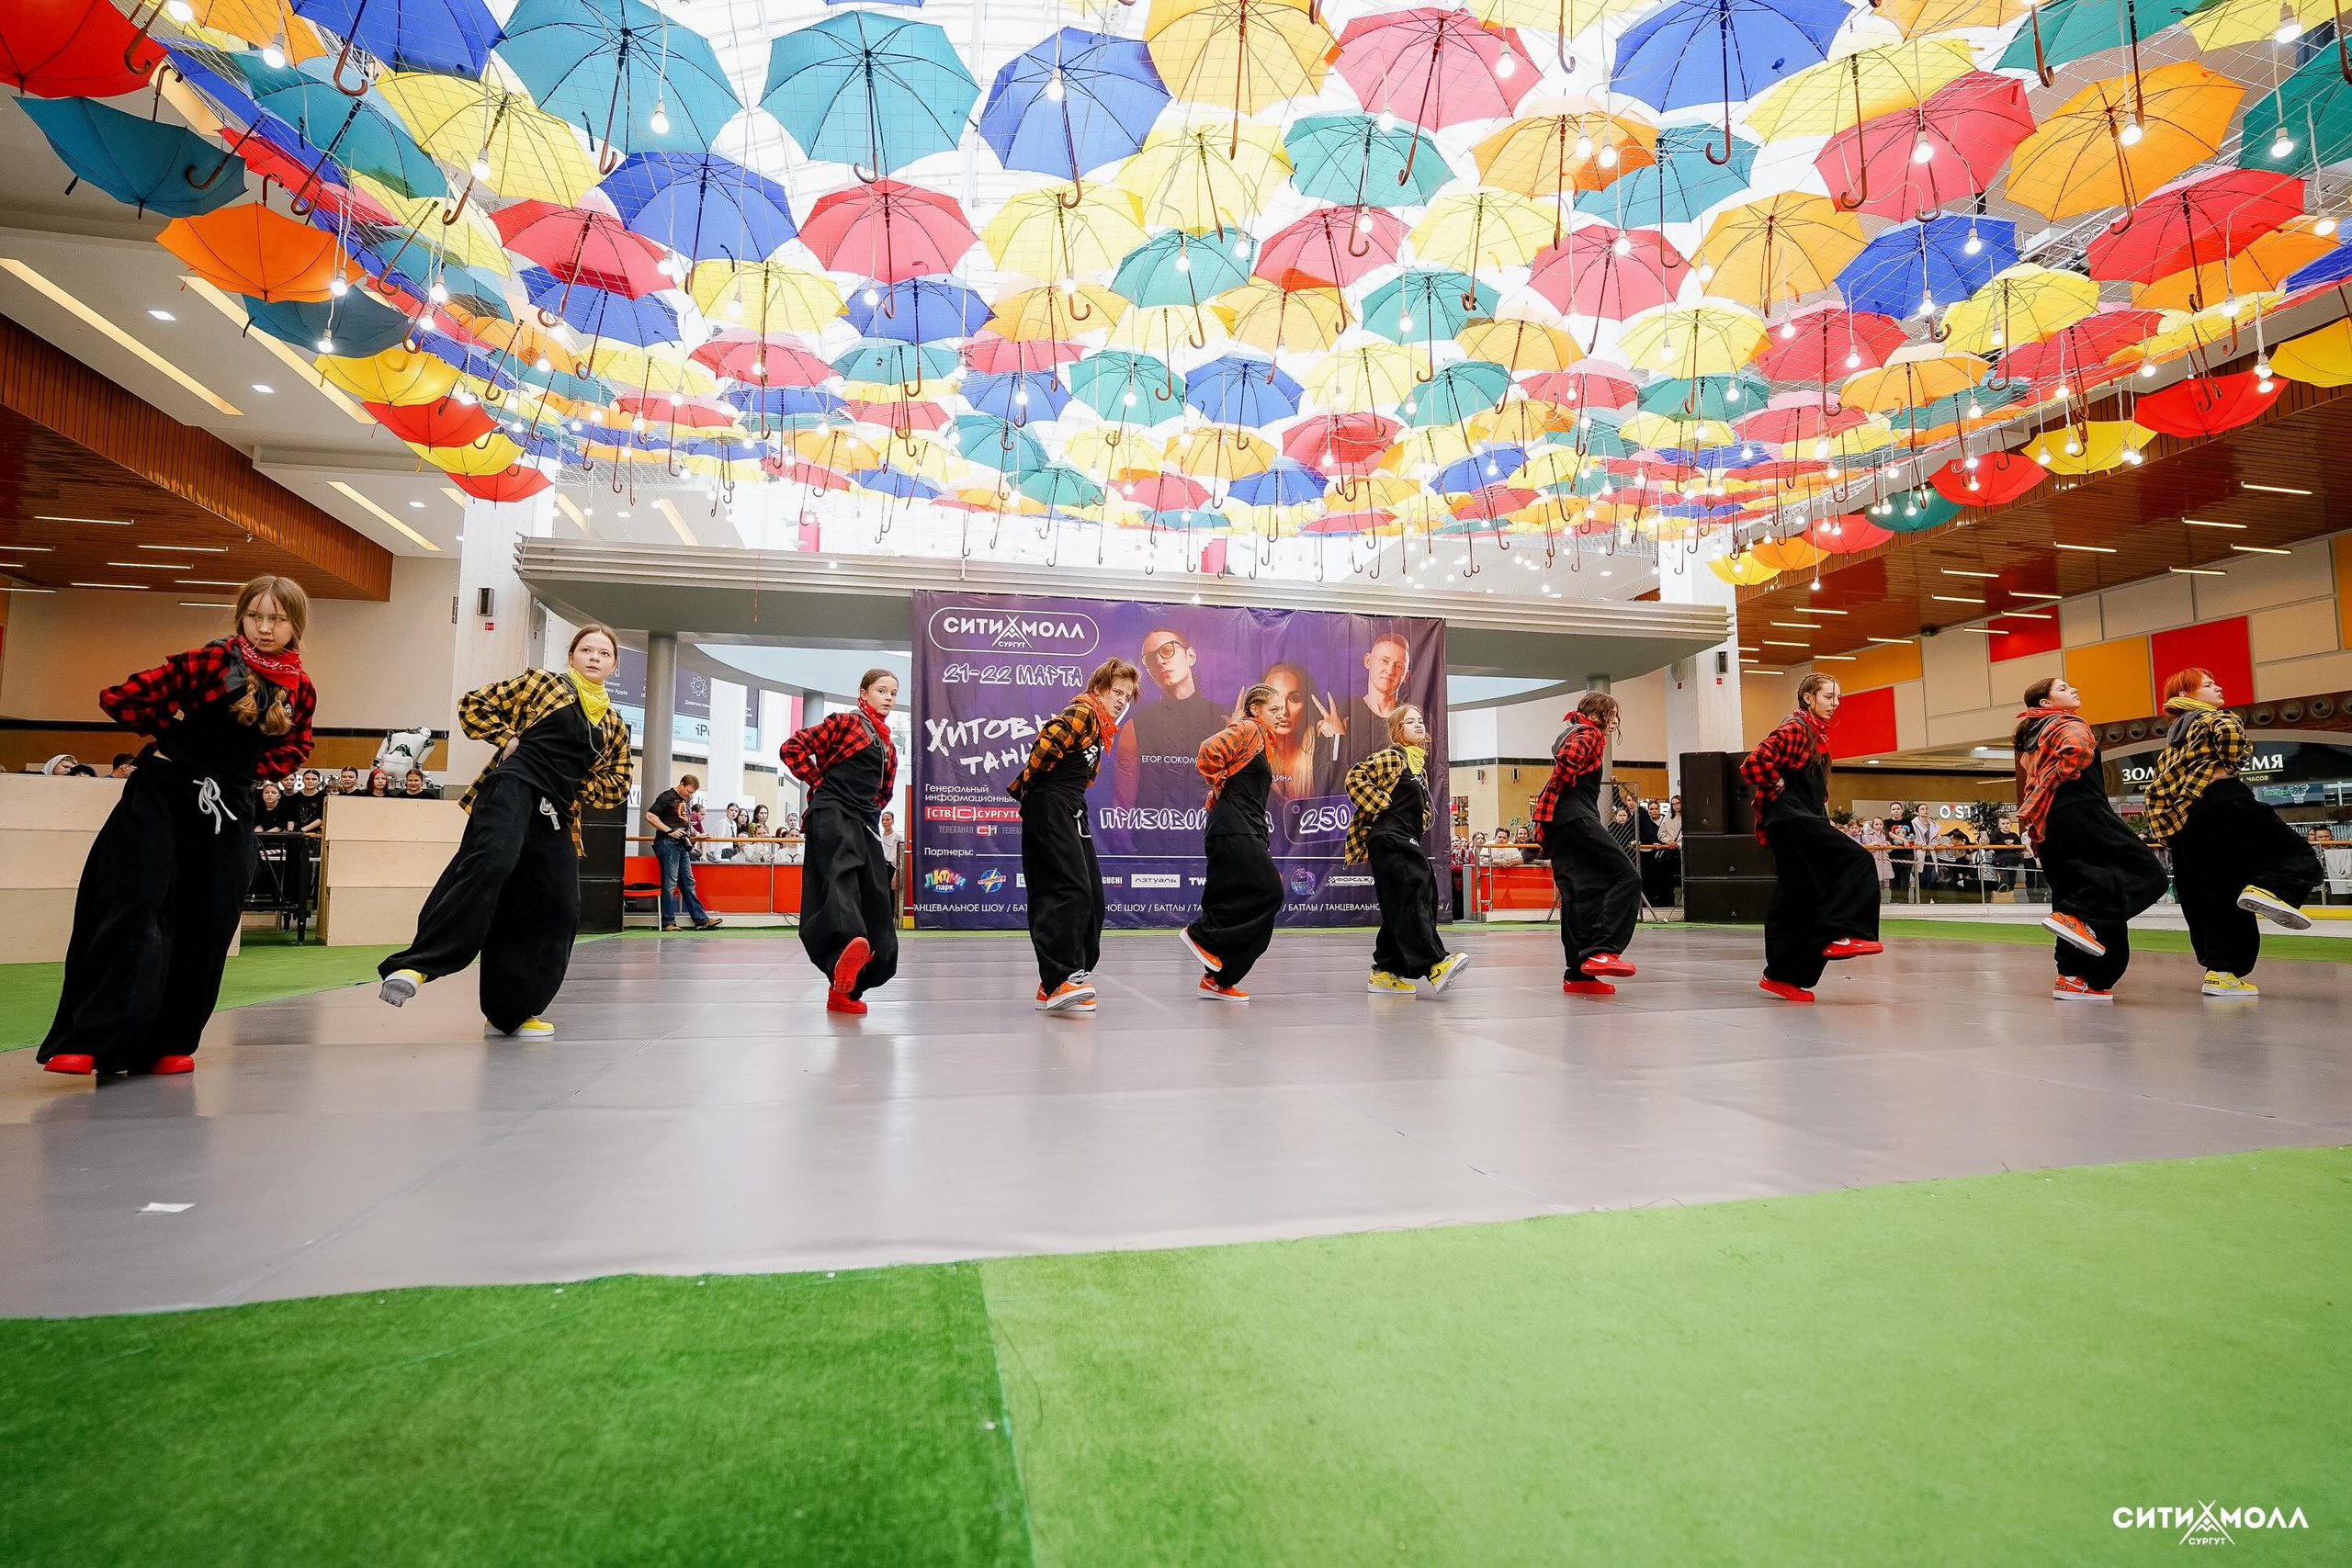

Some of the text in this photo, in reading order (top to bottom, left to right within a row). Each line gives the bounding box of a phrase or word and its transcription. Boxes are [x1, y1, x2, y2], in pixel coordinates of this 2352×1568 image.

[944, 616, 1086, 639] СИТИ МОЛЛ
[942, 662, 1083, 687] 21-22 МАРТА
[1141, 755, 1162, 763] ЕГОР
[2122, 766, 2154, 782] ЗОЛ
[925, 784, 989, 793] Генеральный
[939, 826, 974, 835] ТЕЛЕКАНАЛ
[924, 847, 974, 857] Партнеры:
[913, 903, 980, 913] АНЦЕВАЛЬНОЕ
[981, 903, 1005, 912] ШОУ
[1124, 904, 1147, 912] ШОУ
[1154, 904, 1185, 912] БАТТЛЫ
[1288, 903, 1318, 912] БАТТЛЫ
